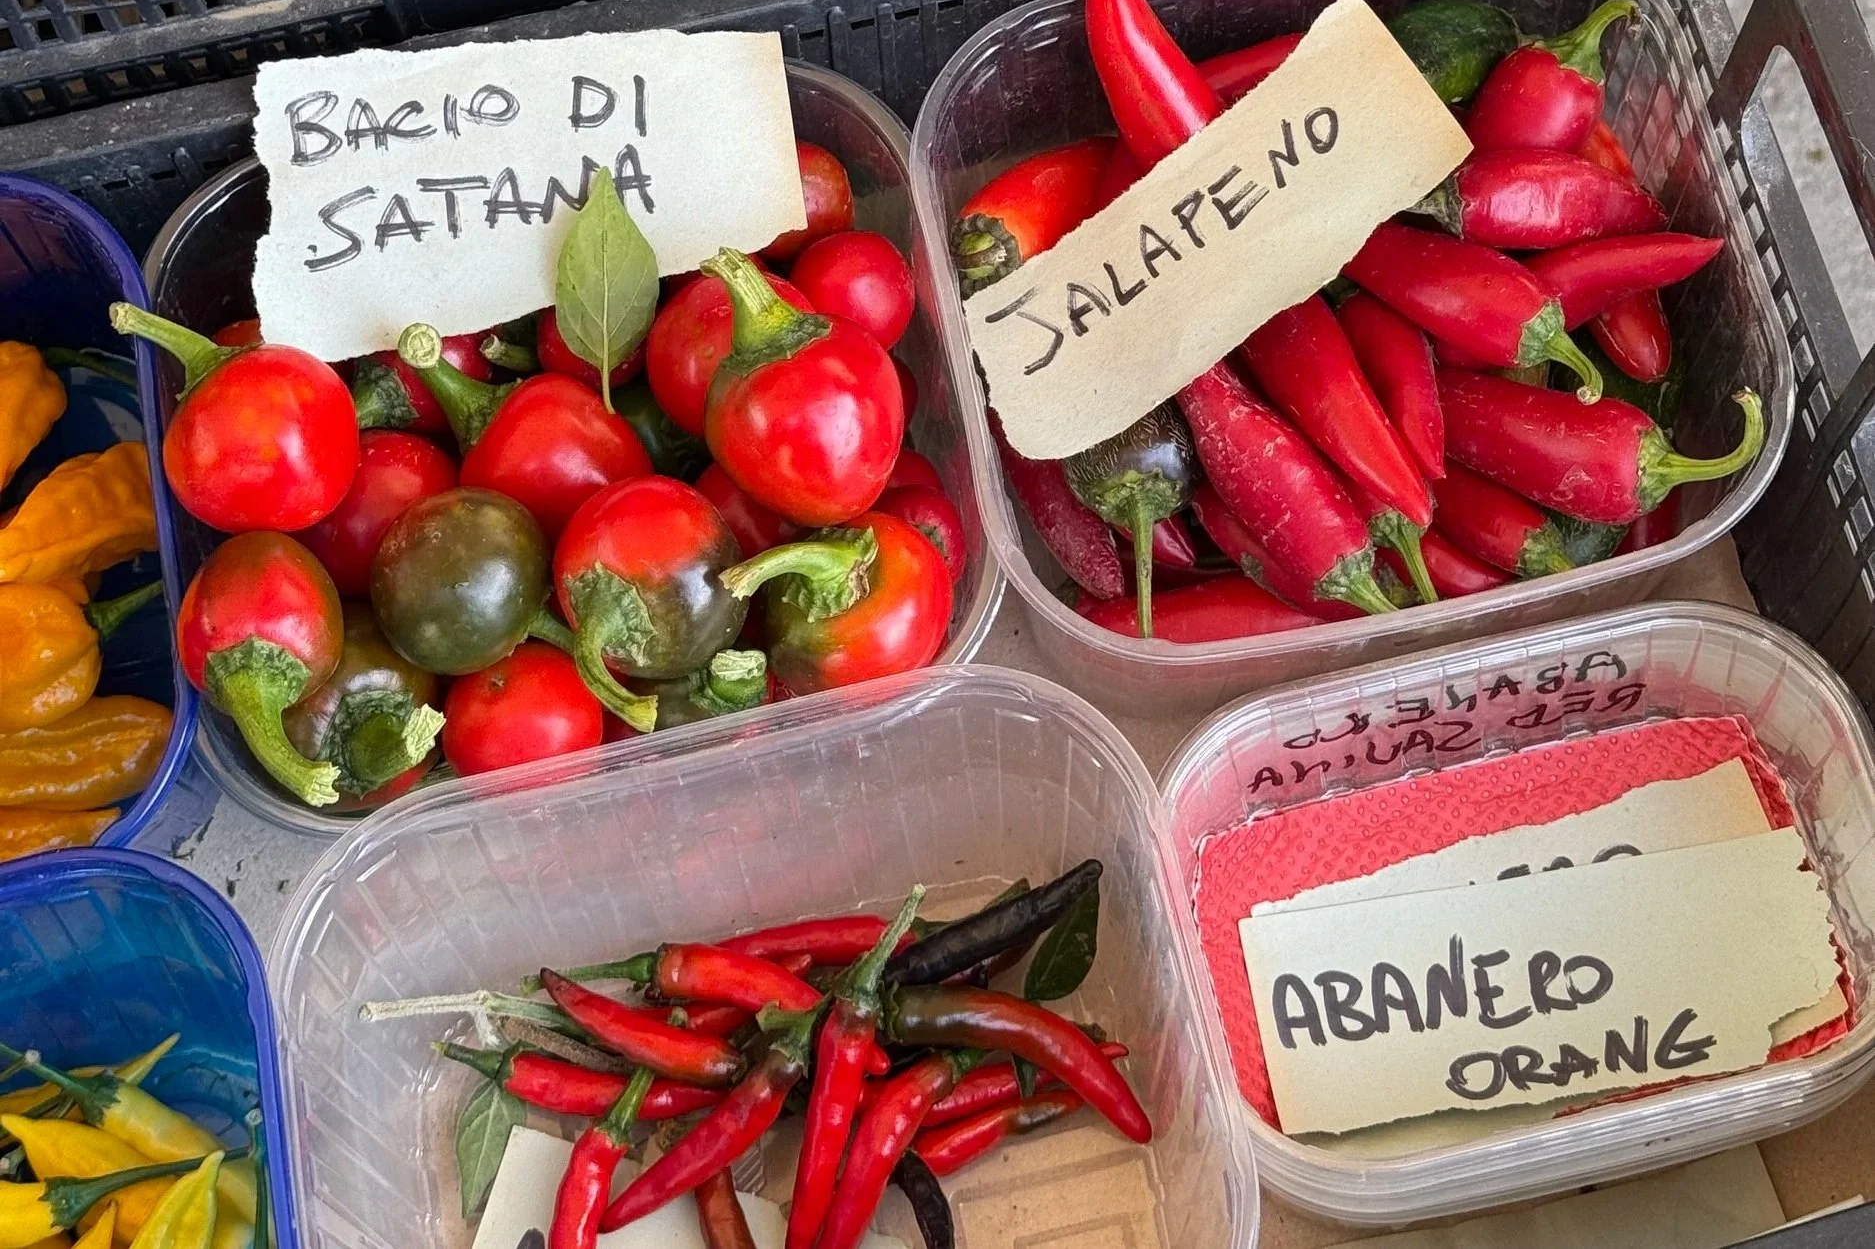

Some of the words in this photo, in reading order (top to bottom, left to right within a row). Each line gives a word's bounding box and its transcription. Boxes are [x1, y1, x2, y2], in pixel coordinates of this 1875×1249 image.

[285, 83, 520, 166] BACIO
[570, 75, 647, 137] DI
[303, 143, 655, 273] SATANA
[985, 106, 1340, 375] JALAPENO
[1271, 933, 1614, 1050] ABANERO
[1445, 1007, 1718, 1100] ORANG
